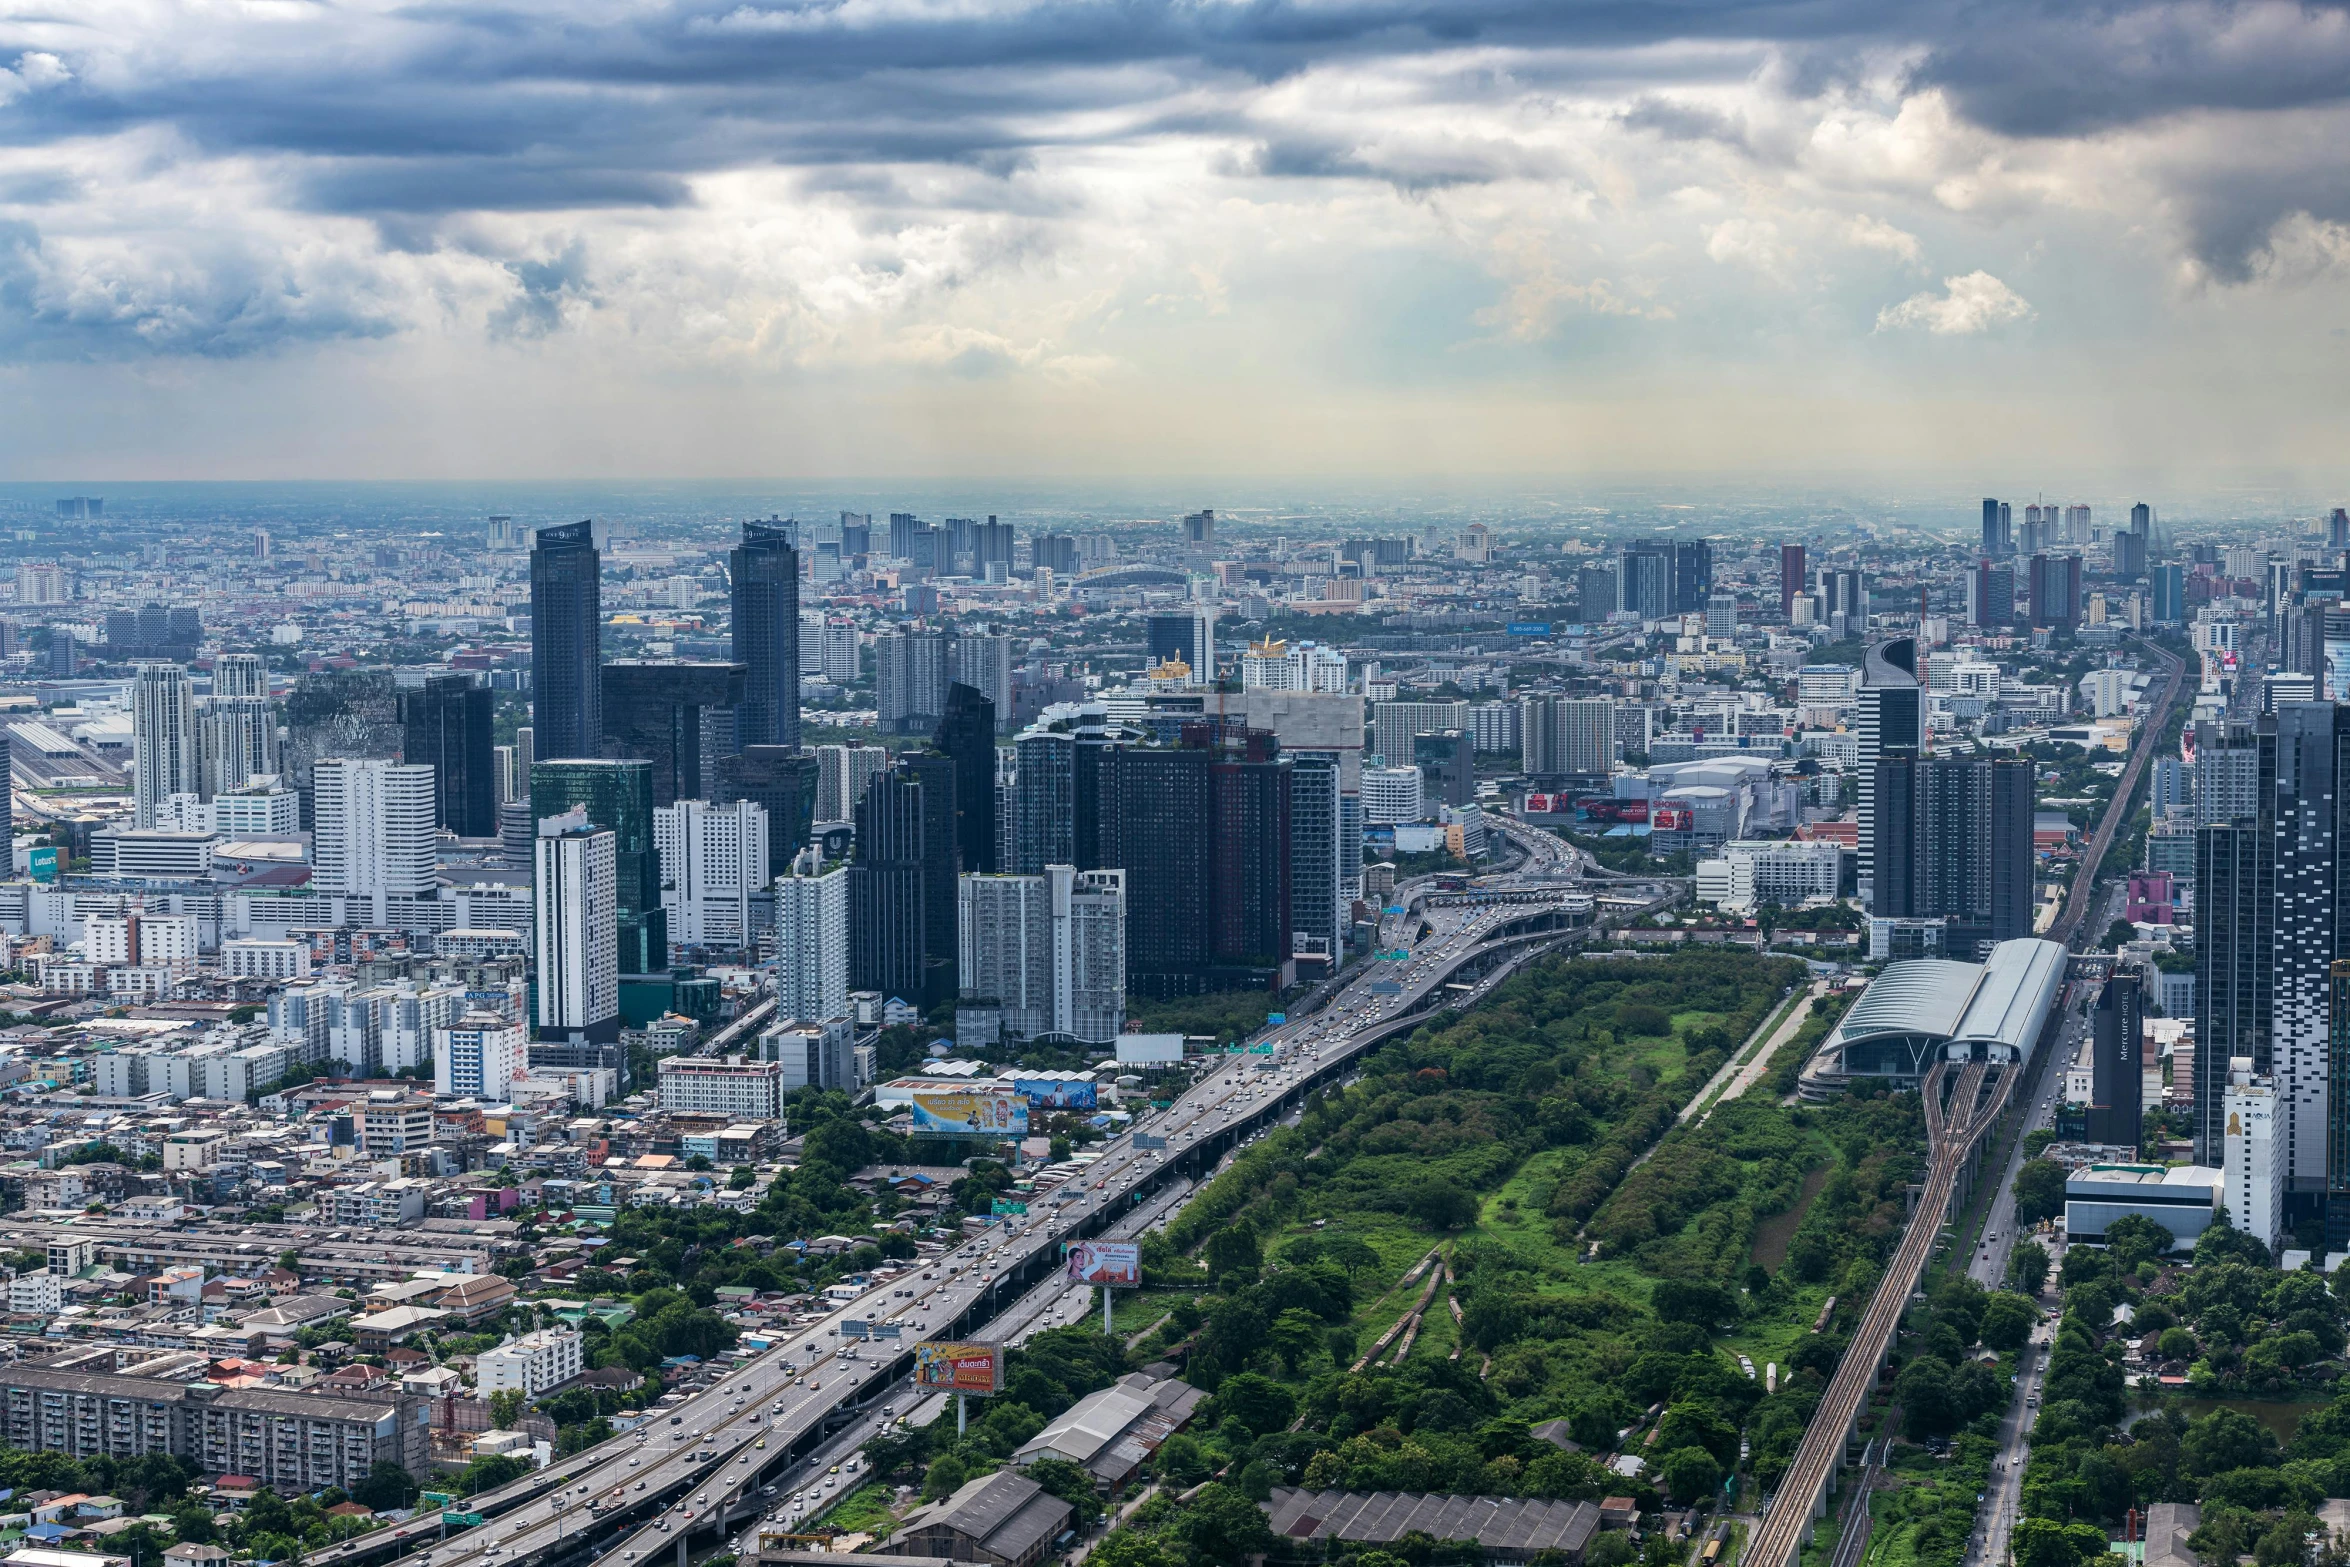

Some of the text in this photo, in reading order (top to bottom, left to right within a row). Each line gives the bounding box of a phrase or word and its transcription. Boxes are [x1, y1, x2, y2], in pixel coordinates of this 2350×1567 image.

[559, 531, 565, 539] 9
[748, 530, 753, 539] 9
[35, 856, 56, 866] Lotus's
[958, 1359, 990, 1368] เต็มตะกร้า
